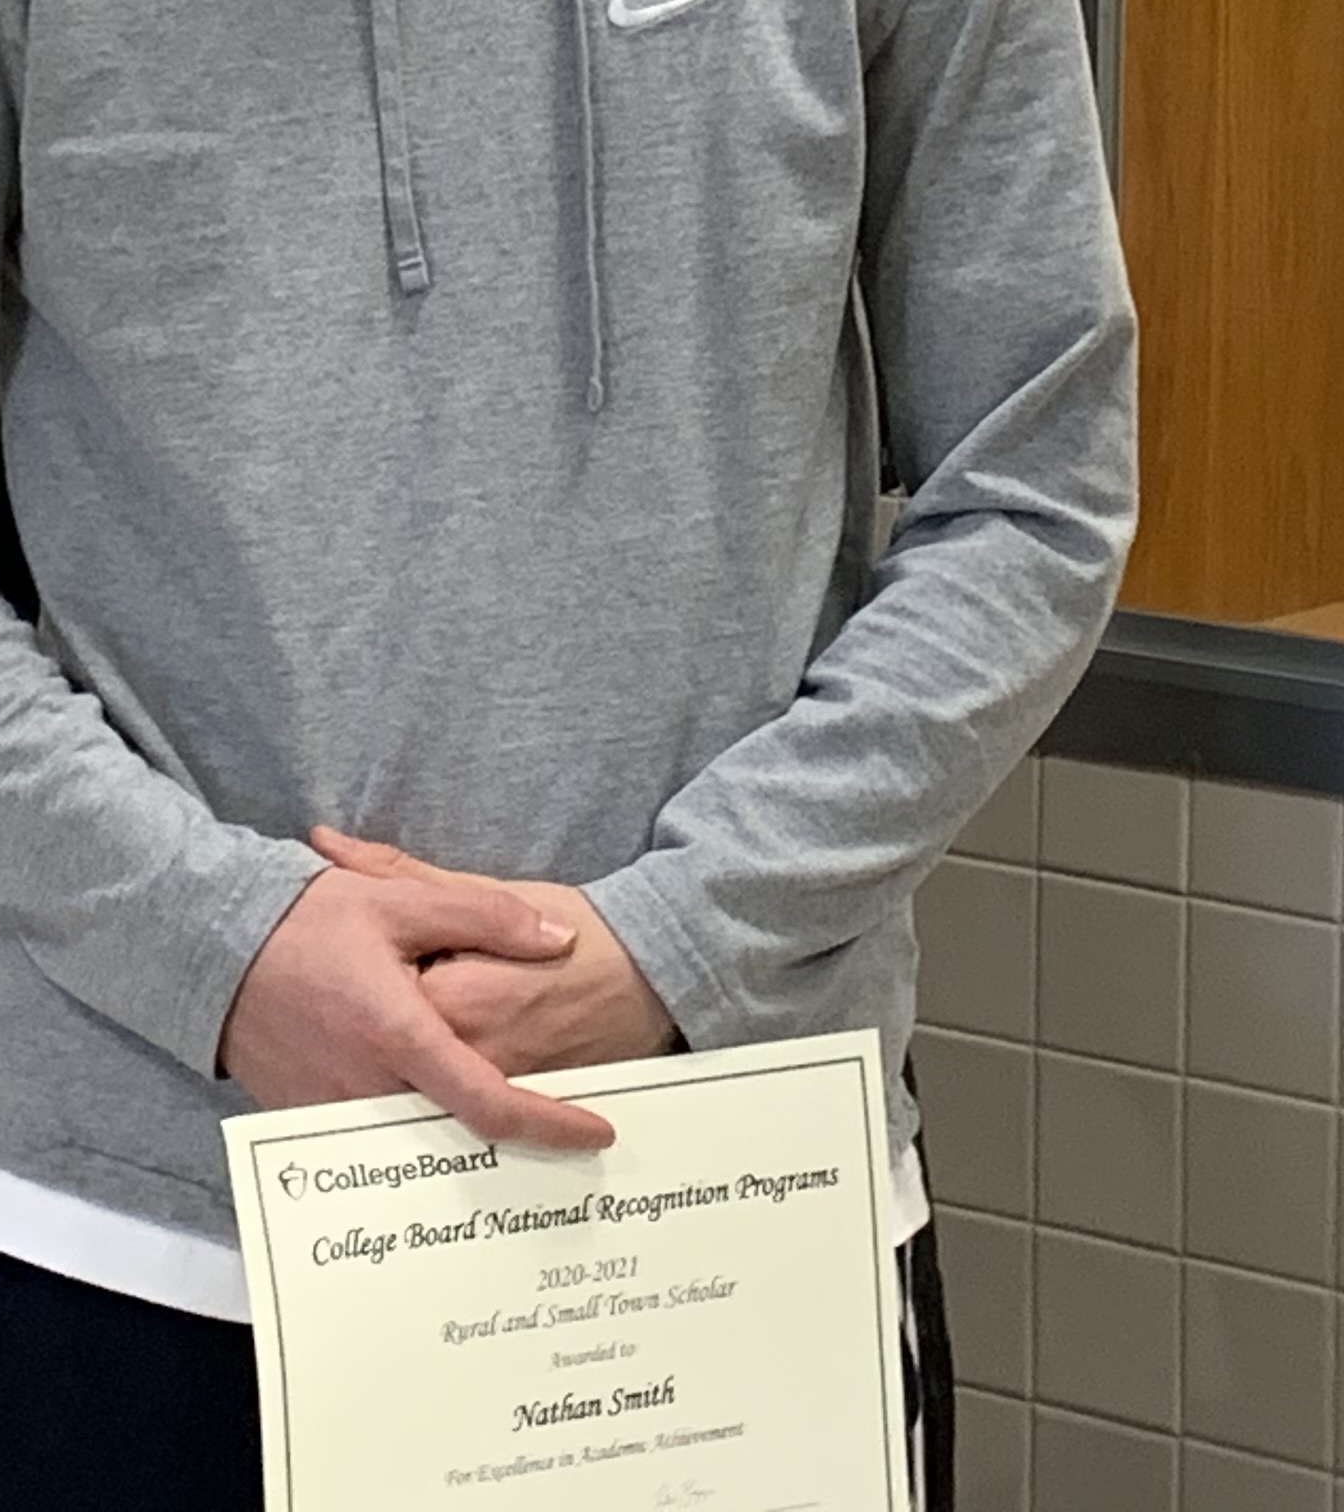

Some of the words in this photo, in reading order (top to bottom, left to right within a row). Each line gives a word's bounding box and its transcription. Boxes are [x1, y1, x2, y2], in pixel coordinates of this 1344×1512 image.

[314, 1144, 499, 1193] CollegeBoard
[312, 1227, 397, 1267] College
[404, 1210, 482, 1250] Board
[483, 1193, 595, 1239] National
[596, 1179, 730, 1223] Recognition
[734, 1166, 840, 1203] Programs
[536, 1255, 638, 1292] 2020-2021
[441, 1309, 501, 1344] Rural
[502, 1303, 541, 1333] and
[543, 1293, 604, 1328] Small
[605, 1291, 661, 1316] Town
[663, 1275, 739, 1309] Scholar
[512, 1392, 603, 1433] Nathan
[607, 1375, 676, 1417] Smith
[445, 1468, 472, 1487] For
[475, 1455, 555, 1483] Excellence
[558, 1452, 575, 1467] in
